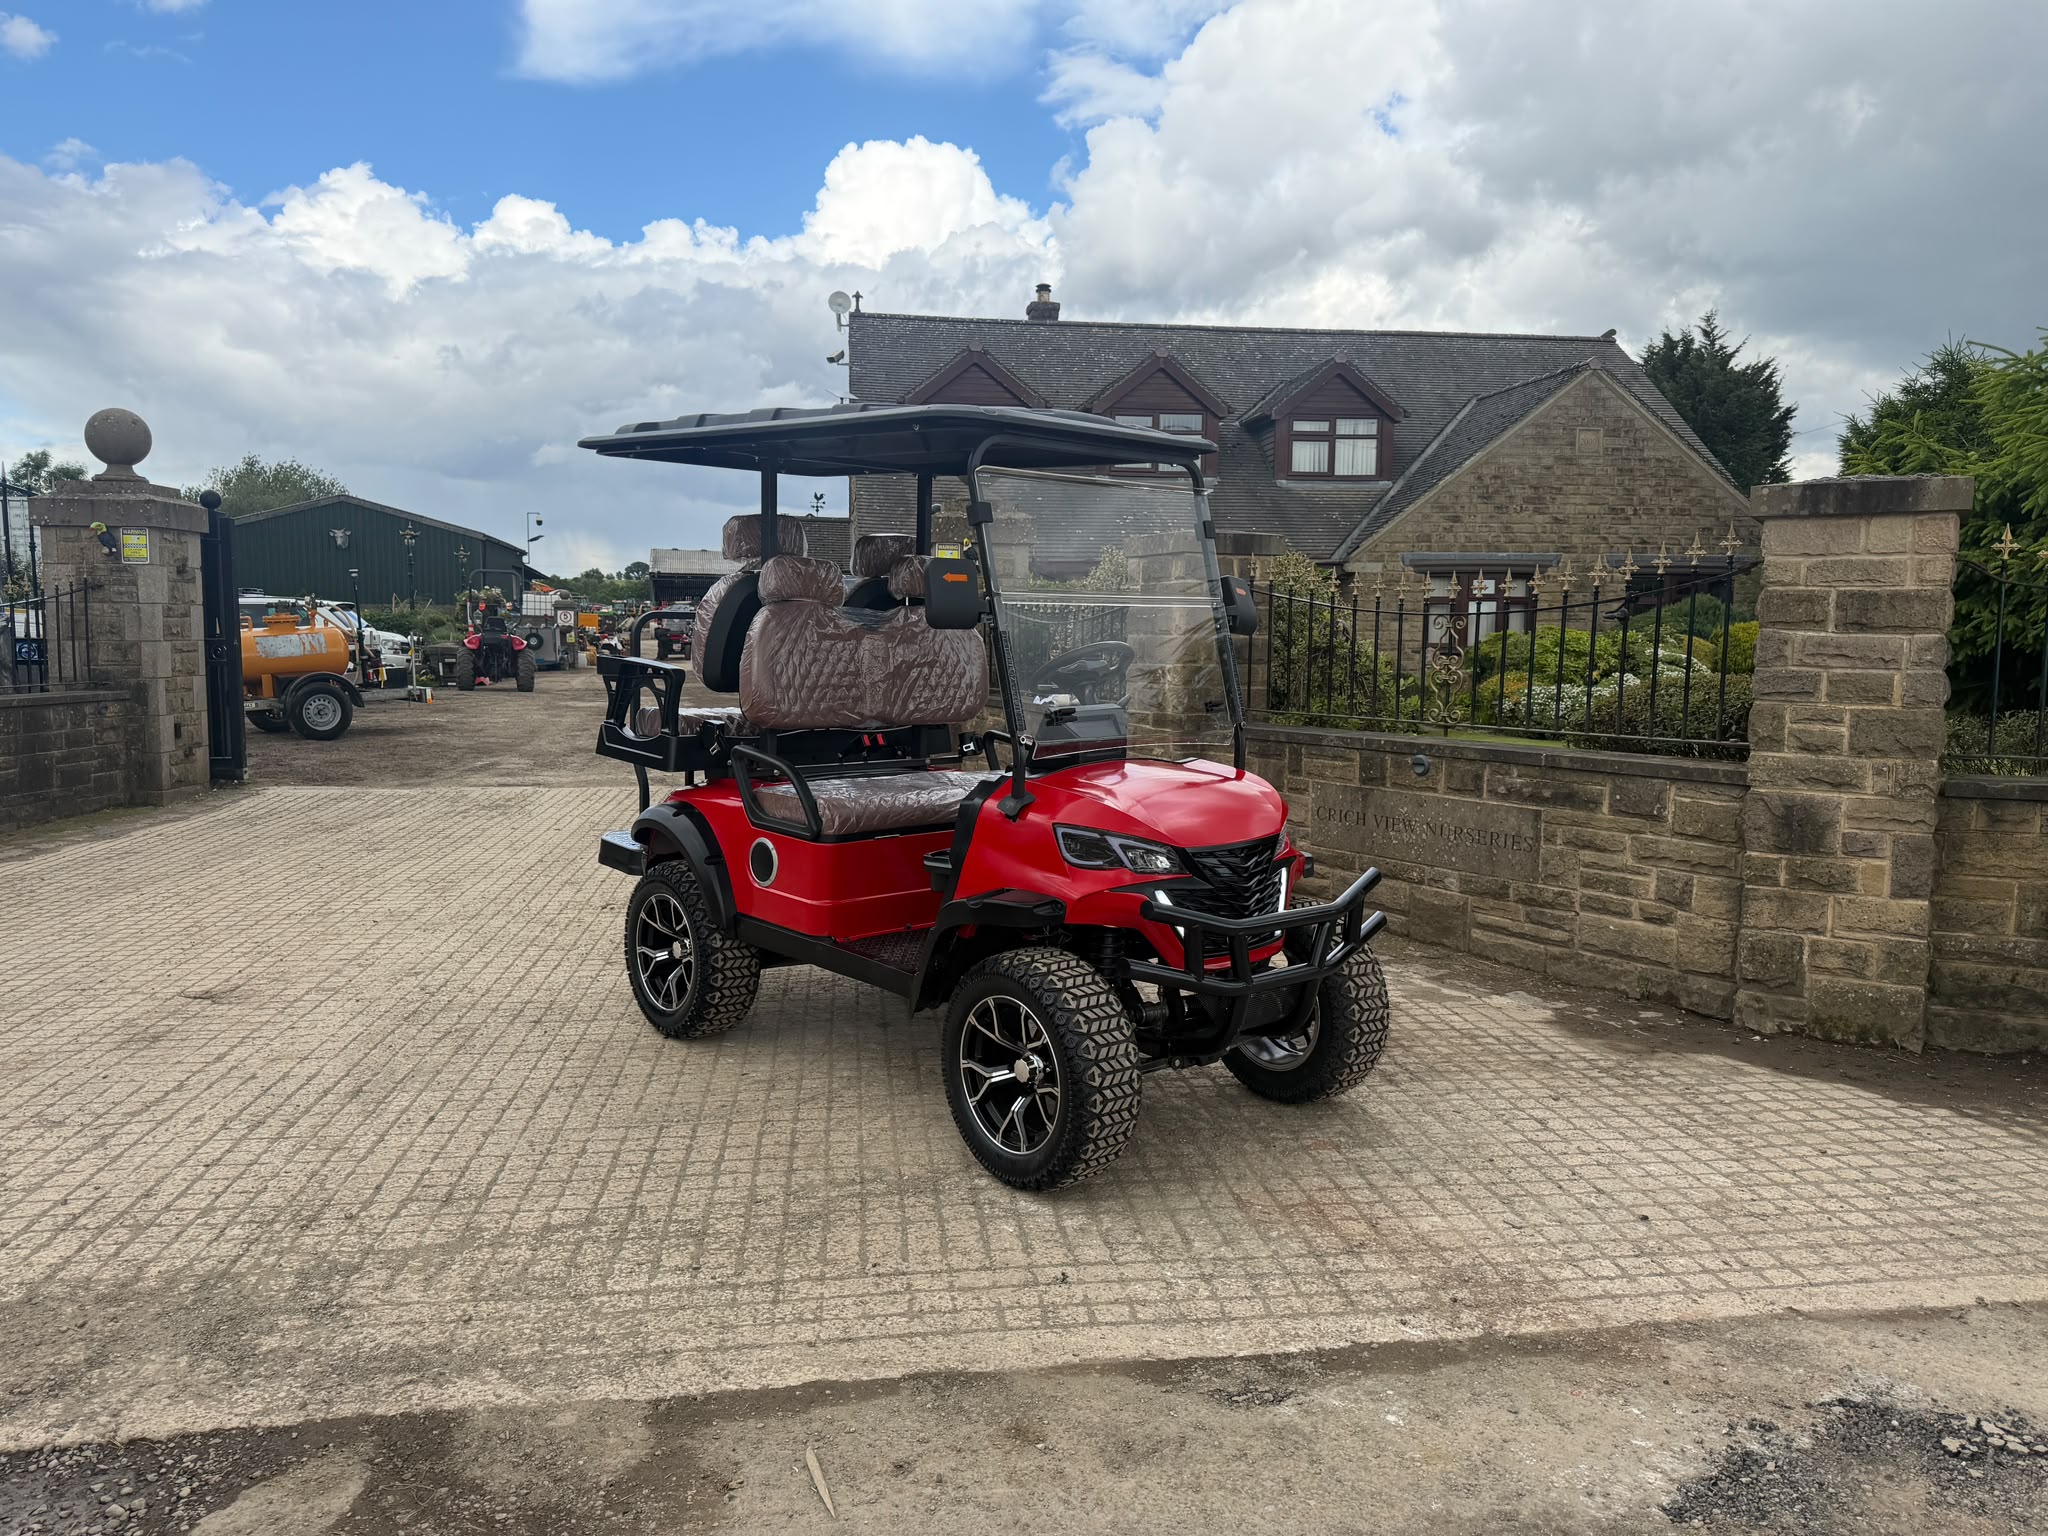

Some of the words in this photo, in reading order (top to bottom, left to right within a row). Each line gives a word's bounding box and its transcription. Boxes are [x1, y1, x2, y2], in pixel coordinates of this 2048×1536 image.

[1316, 805, 1367, 827] CRICH
[1373, 814, 1419, 835] VIEW
[1425, 821, 1535, 854] NURSERIES
